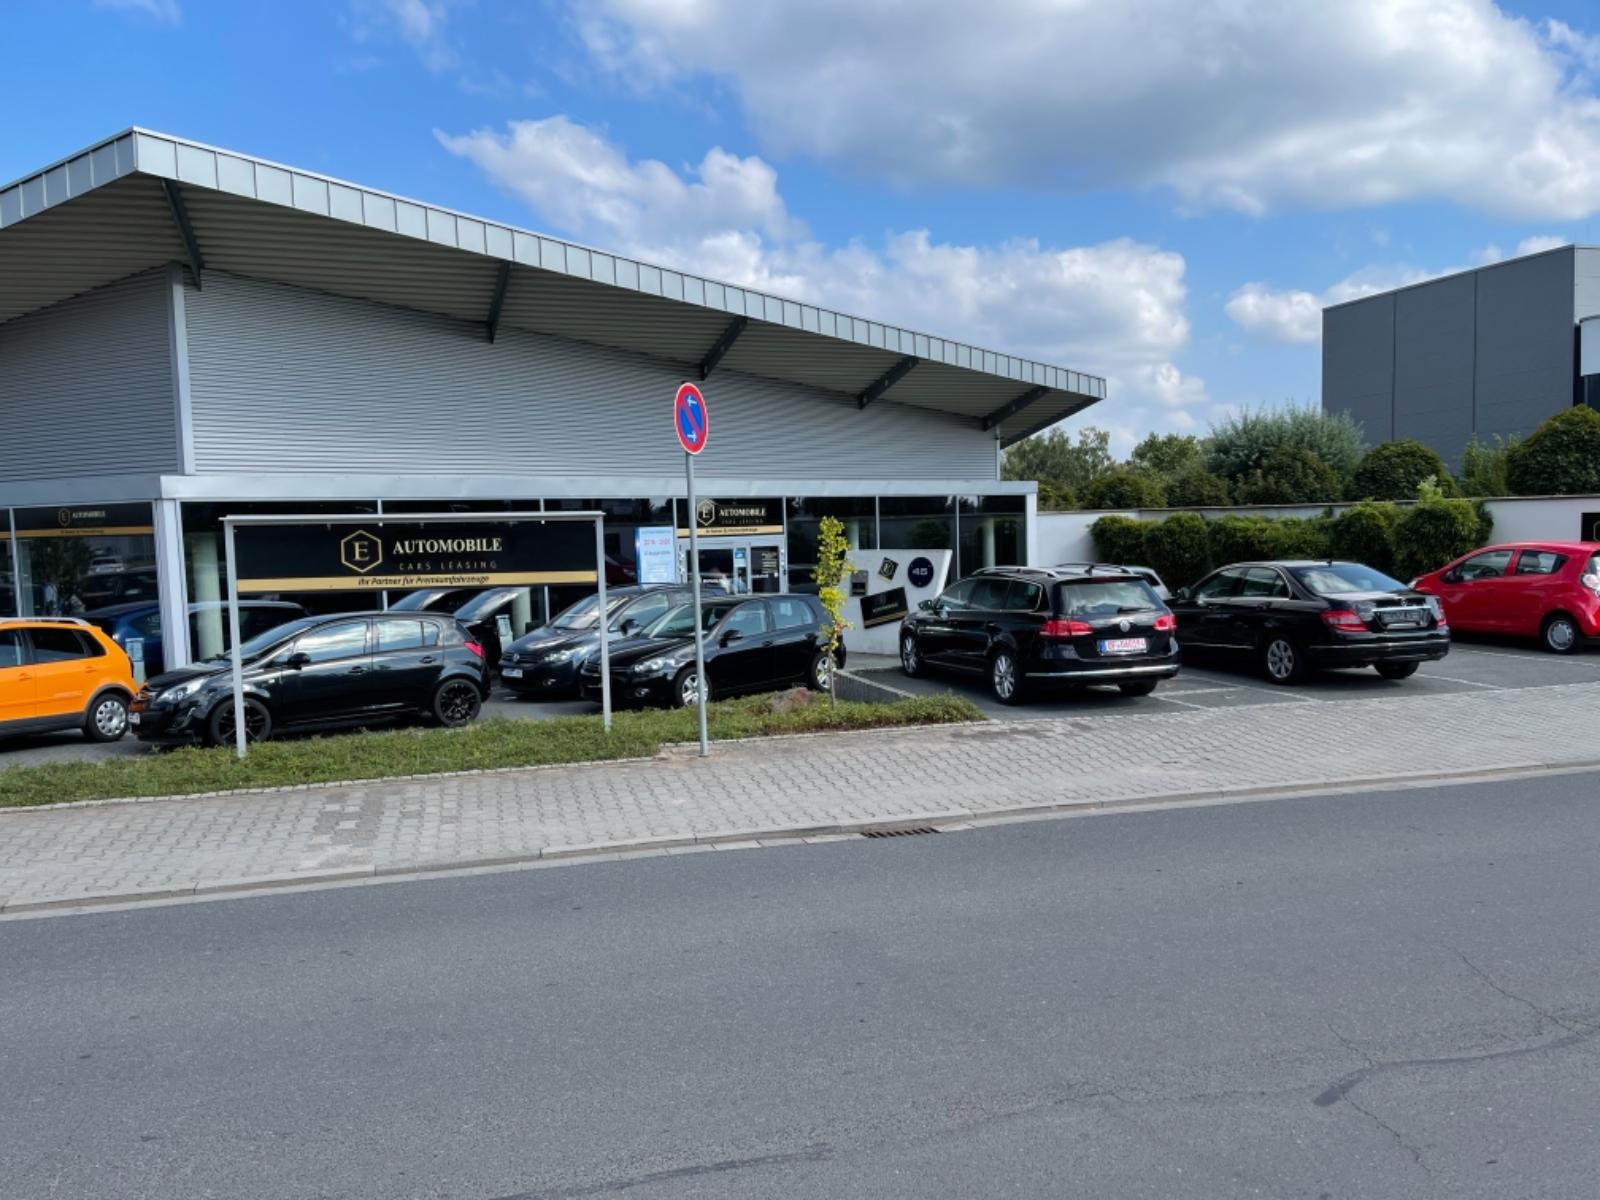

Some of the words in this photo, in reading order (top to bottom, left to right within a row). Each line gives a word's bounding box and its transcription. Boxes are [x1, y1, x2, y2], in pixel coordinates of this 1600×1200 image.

[353, 541, 370, 561] E
[392, 537, 503, 555] AUTOMOBILE
[399, 561, 432, 571] CARS
[441, 560, 497, 571] LEASING
[371, 576, 401, 586] Partner
[402, 576, 415, 587] für
